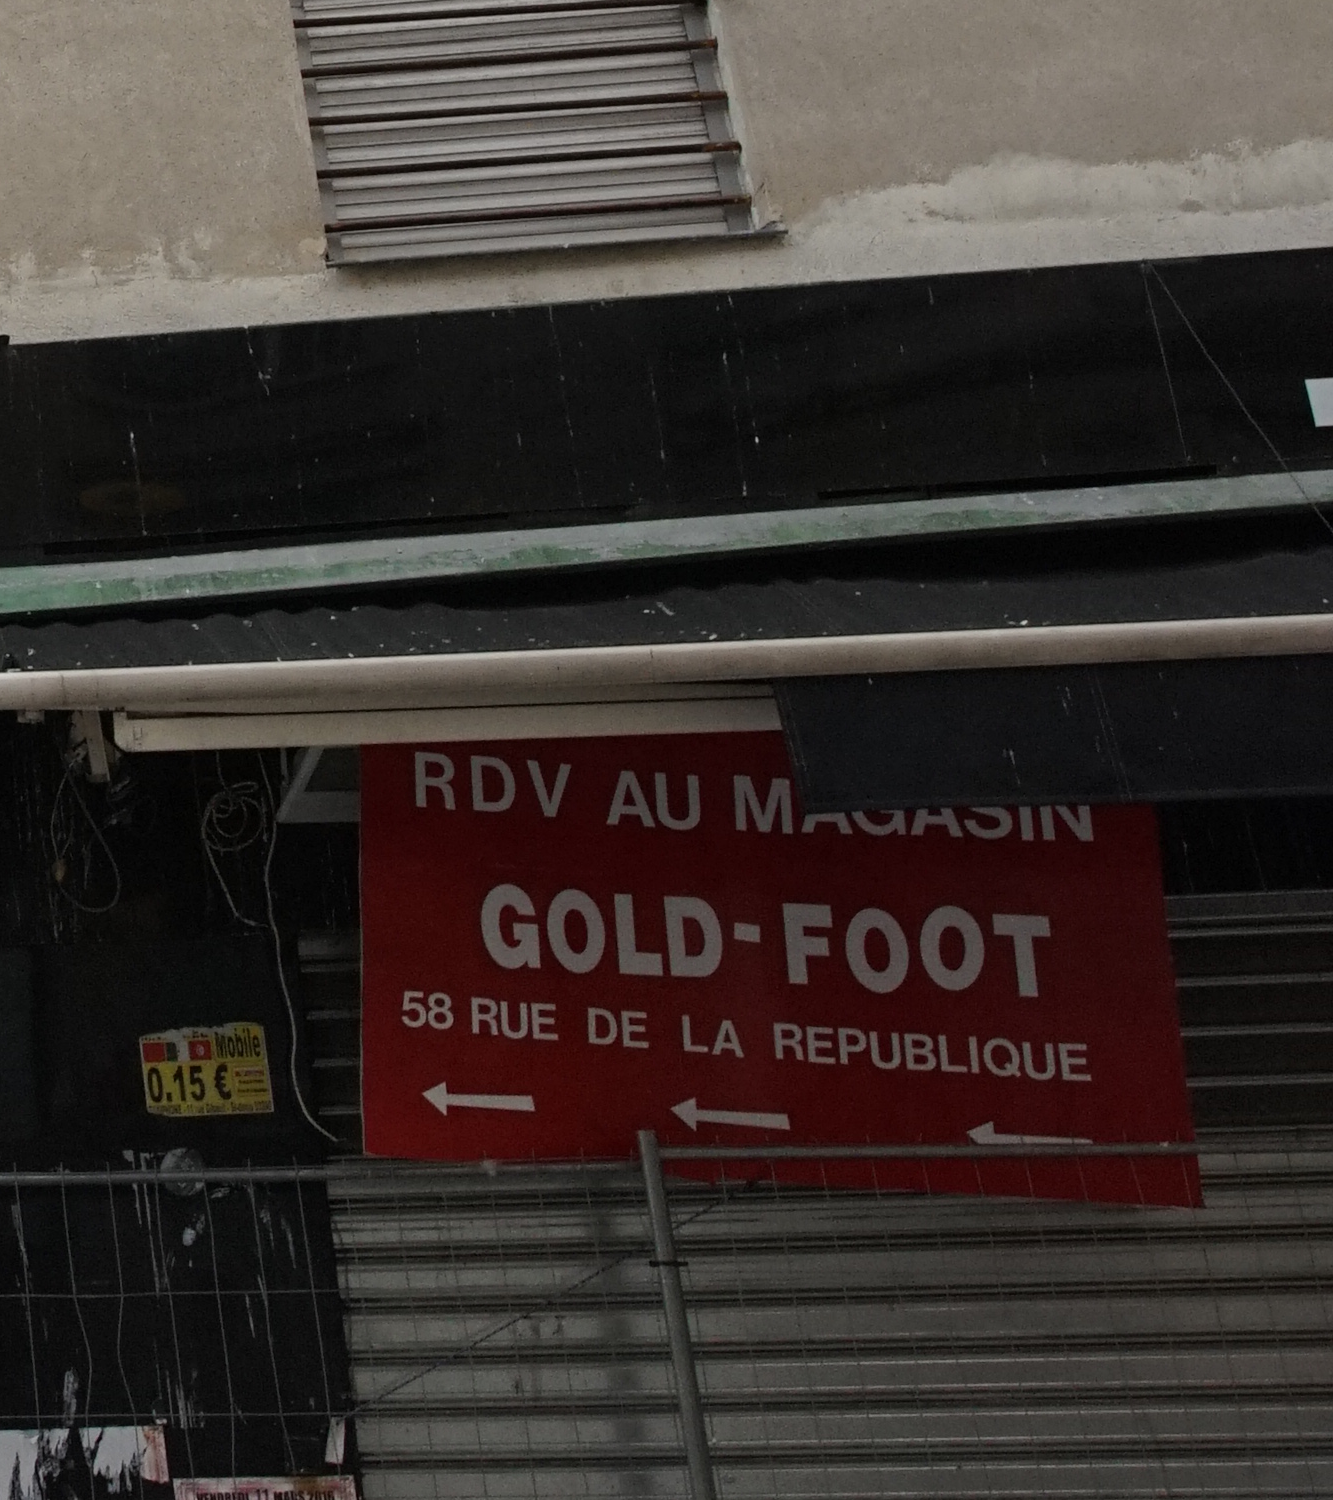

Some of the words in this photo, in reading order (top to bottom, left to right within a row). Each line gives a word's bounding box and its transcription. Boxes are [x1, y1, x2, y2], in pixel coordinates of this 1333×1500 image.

[414, 750, 573, 819] RDV
[606, 770, 702, 831] AU
[480, 882, 1052, 998] GOLD-FOOT
[213, 1027, 261, 1059] Mobile
[400, 990, 455, 1030] 58
[470, 996, 559, 1042] RUE
[586, 1006, 650, 1049] DE
[681, 1014, 745, 1059] LA
[772, 1021, 1092, 1082] REPUBLIQUE
[147, 1065, 206, 1103] 0.15
[213, 1062, 232, 1101] €
